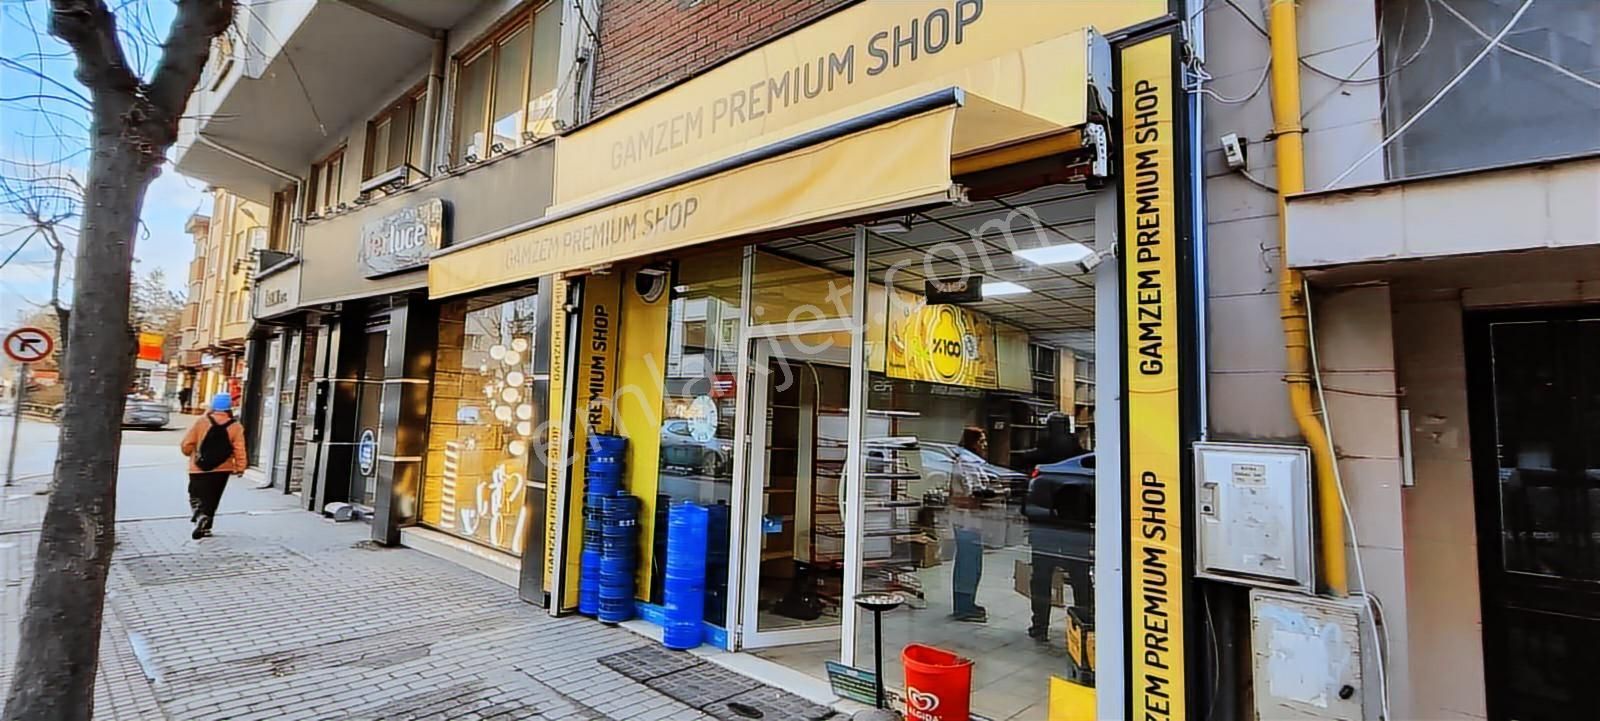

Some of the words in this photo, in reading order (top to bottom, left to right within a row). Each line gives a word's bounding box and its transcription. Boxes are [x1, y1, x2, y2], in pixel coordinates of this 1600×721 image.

[611, 106, 704, 171] GAMZEM
[711, 45, 855, 135] PREMIUM
[866, 0, 984, 76] SHOP
[1134, 79, 1159, 145] SHOP
[505, 234, 560, 270] GAMZEM
[562, 213, 638, 254] PREMIUM
[642, 197, 699, 237] SHOP
[1136, 149, 1161, 263] PREMIUM
[592, 304, 609, 352] SHOP
[932, 337, 961, 358] %100
[1136, 270, 1163, 376] GAMZEM
[587, 355, 607, 435] PREMIUM
[1141, 471, 1167, 542] SHOP
[1142, 547, 1169, 671] PREMIUM
[1144, 674, 1171, 721] ZEM
